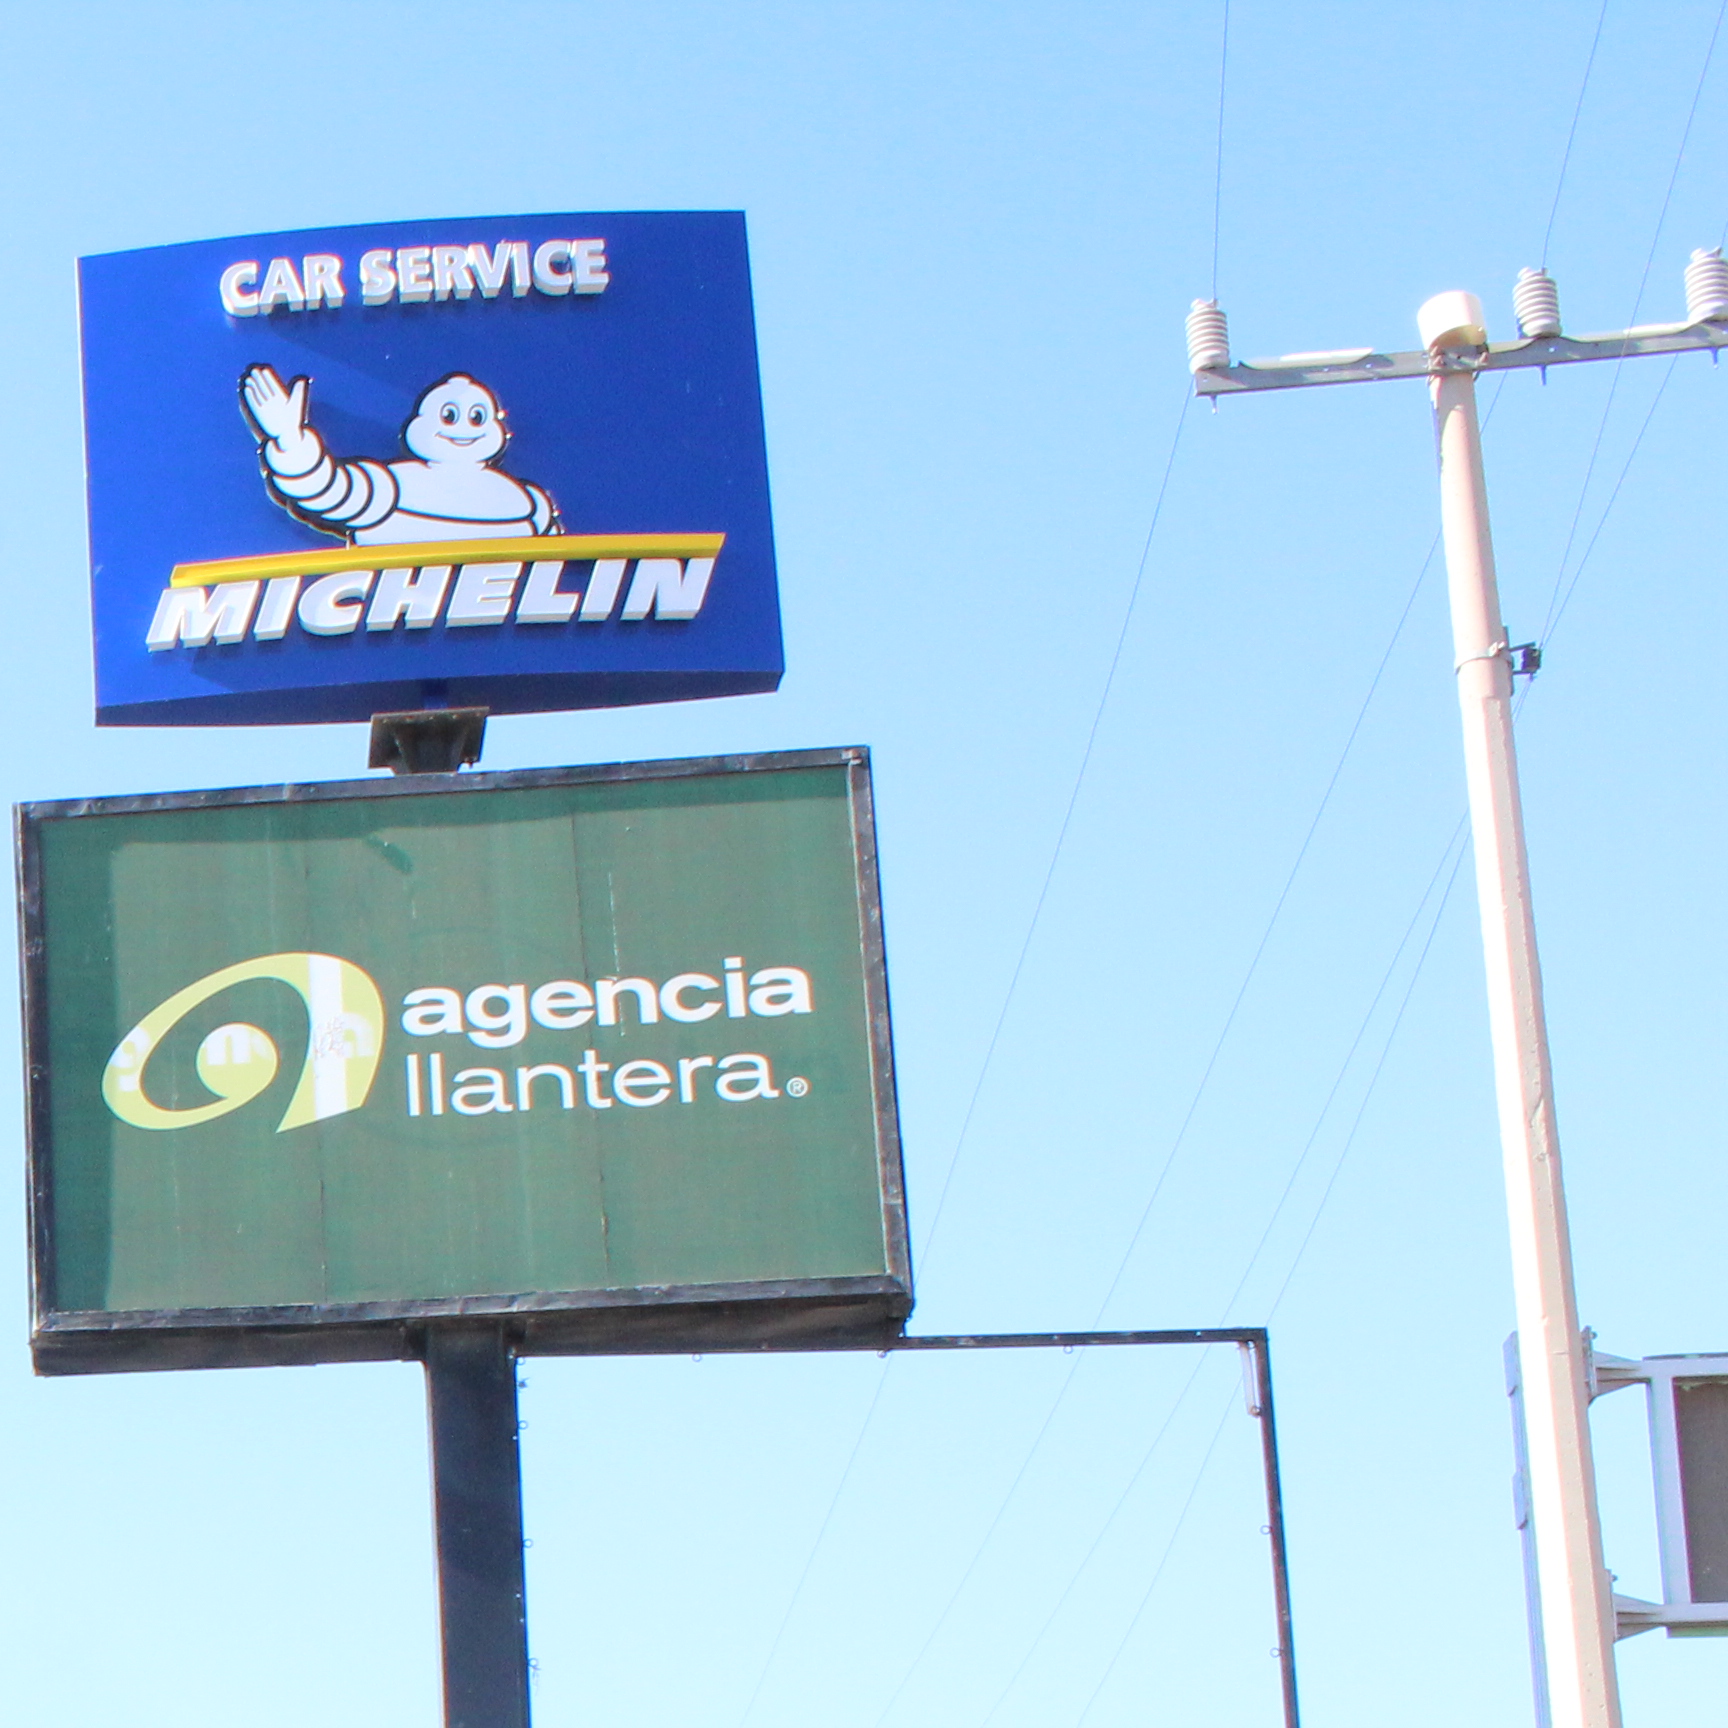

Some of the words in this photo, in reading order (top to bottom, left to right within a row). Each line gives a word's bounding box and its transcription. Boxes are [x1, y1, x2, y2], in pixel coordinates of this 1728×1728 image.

[219, 255, 345, 318] CAR
[359, 238, 609, 306] SERVICE
[145, 557, 715, 653] MICHELIN
[400, 955, 814, 1050] agencia
